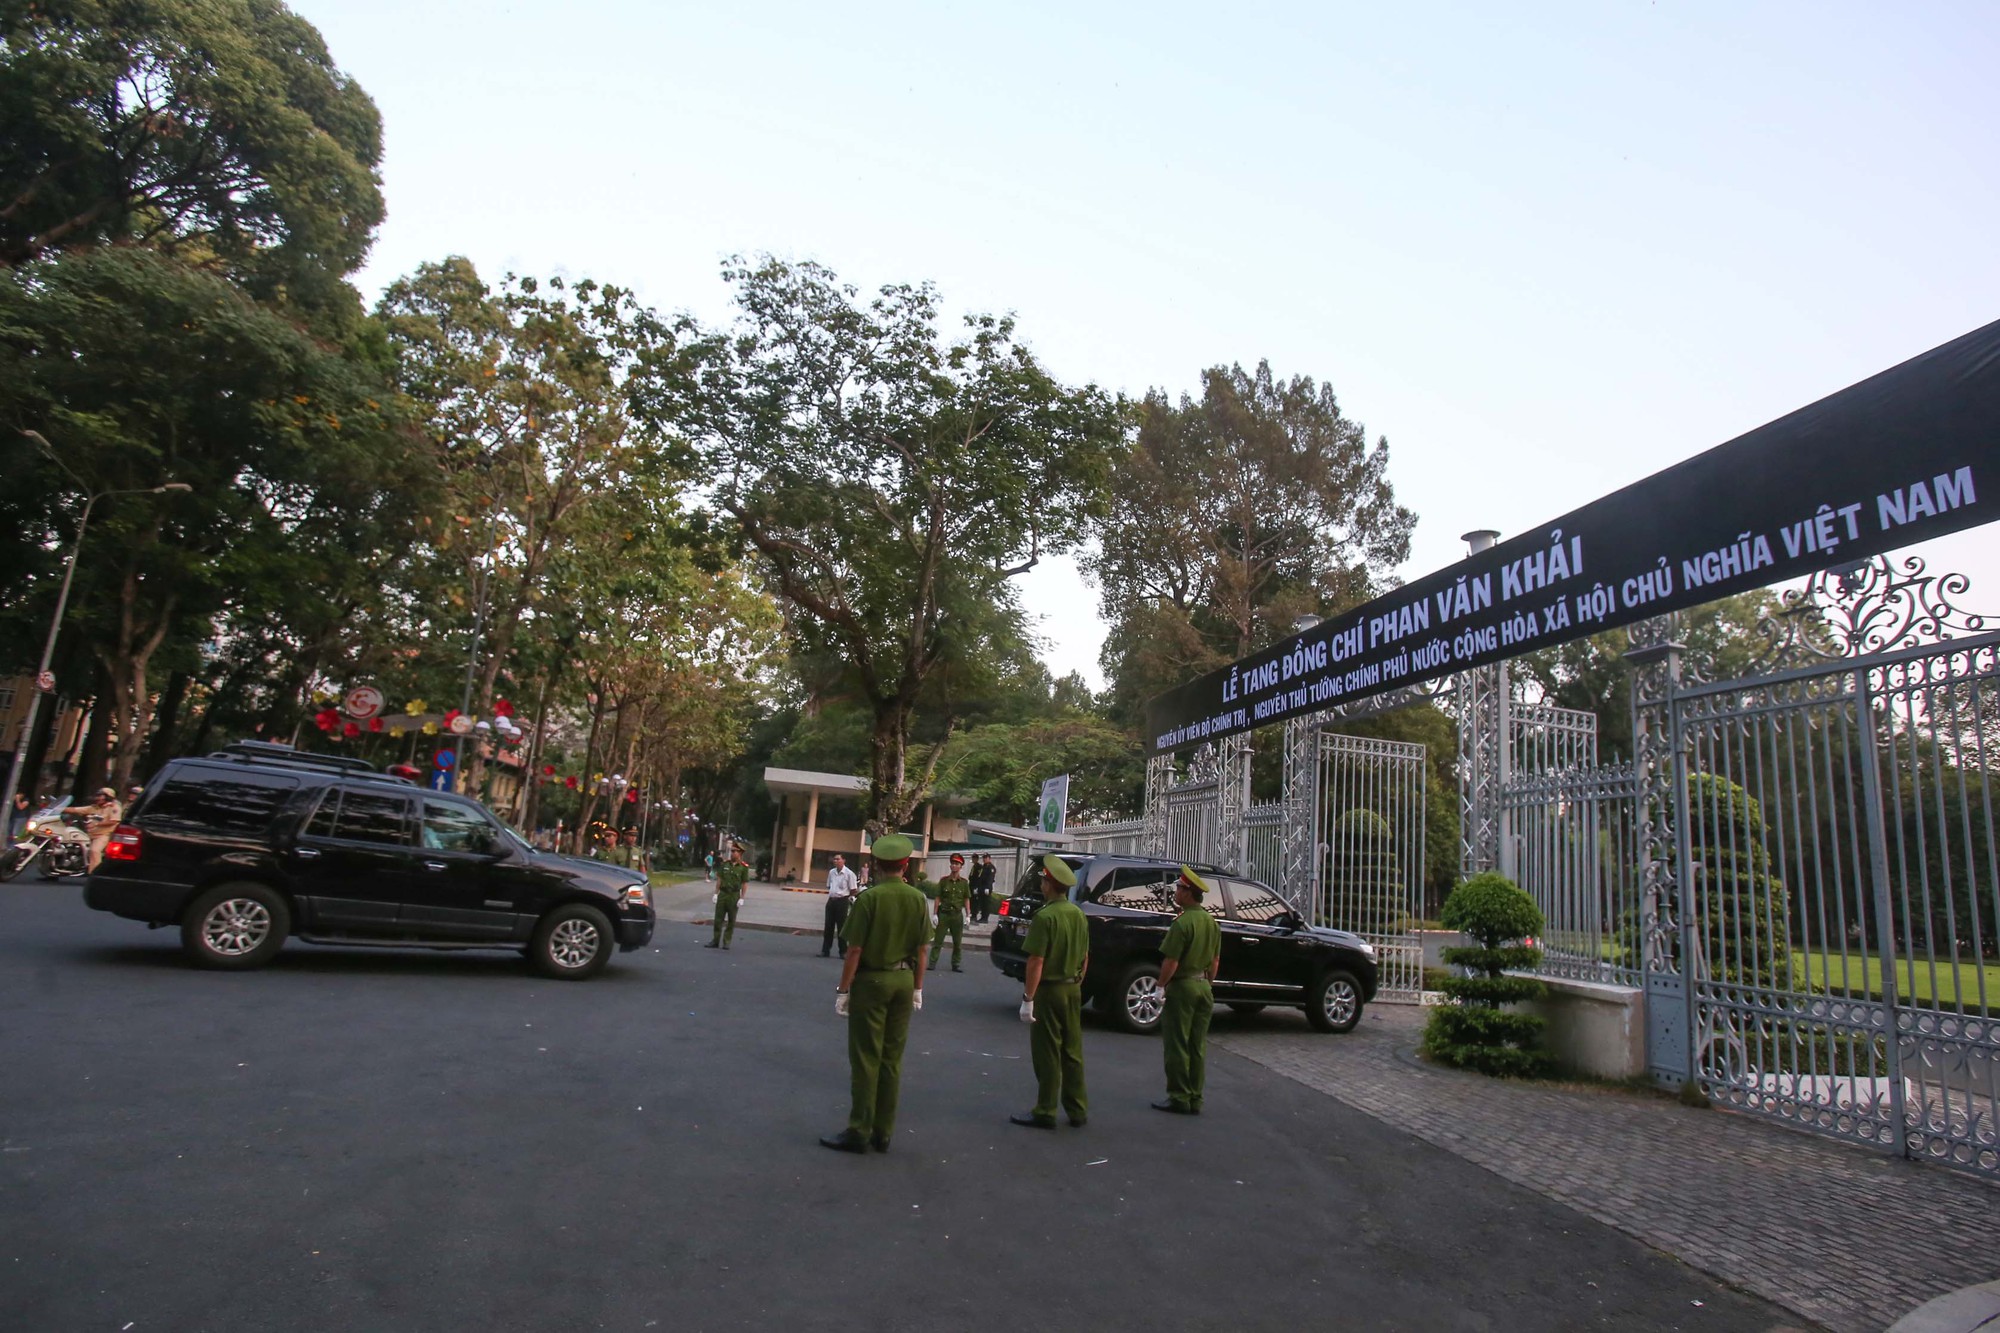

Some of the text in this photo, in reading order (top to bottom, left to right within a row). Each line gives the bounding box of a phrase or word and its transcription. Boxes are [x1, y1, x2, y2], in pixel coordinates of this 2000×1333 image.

[1156, 729, 1177, 749] NGUYÊN
[1178, 724, 1186, 742] ỦY
[1187, 721, 1200, 740] VIÊN
[1201, 716, 1210, 737] BỘ
[1212, 711, 1232, 732] CHÍNH
[1254, 692, 1287, 721] NGUYÊN
[1289, 681, 1307, 709] THỦ
[1309, 675, 1343, 703] TƯỚNG
[1345, 661, 1379, 692] CHÍNH
[1383, 647, 1408, 681] PHỦ
[1412, 637, 1450, 671] NƯỚC
[1454, 627, 1497, 661] CỘNG
[1501, 610, 1539, 646] HÒA
[1543, 594, 1570, 633] XÃ
[1576, 582, 1616, 622] HỘI
[1622, 557, 1673, 608] CHỦ
[1682, 531, 1774, 590] NGHĨA
[1781, 502, 1861, 558] VIỆT
[1876, 465, 1976, 531] NAM
[1223, 528, 1583, 703] LỄ TANG ĐỒNG CHÍ PHAN VĂN KHẢI
